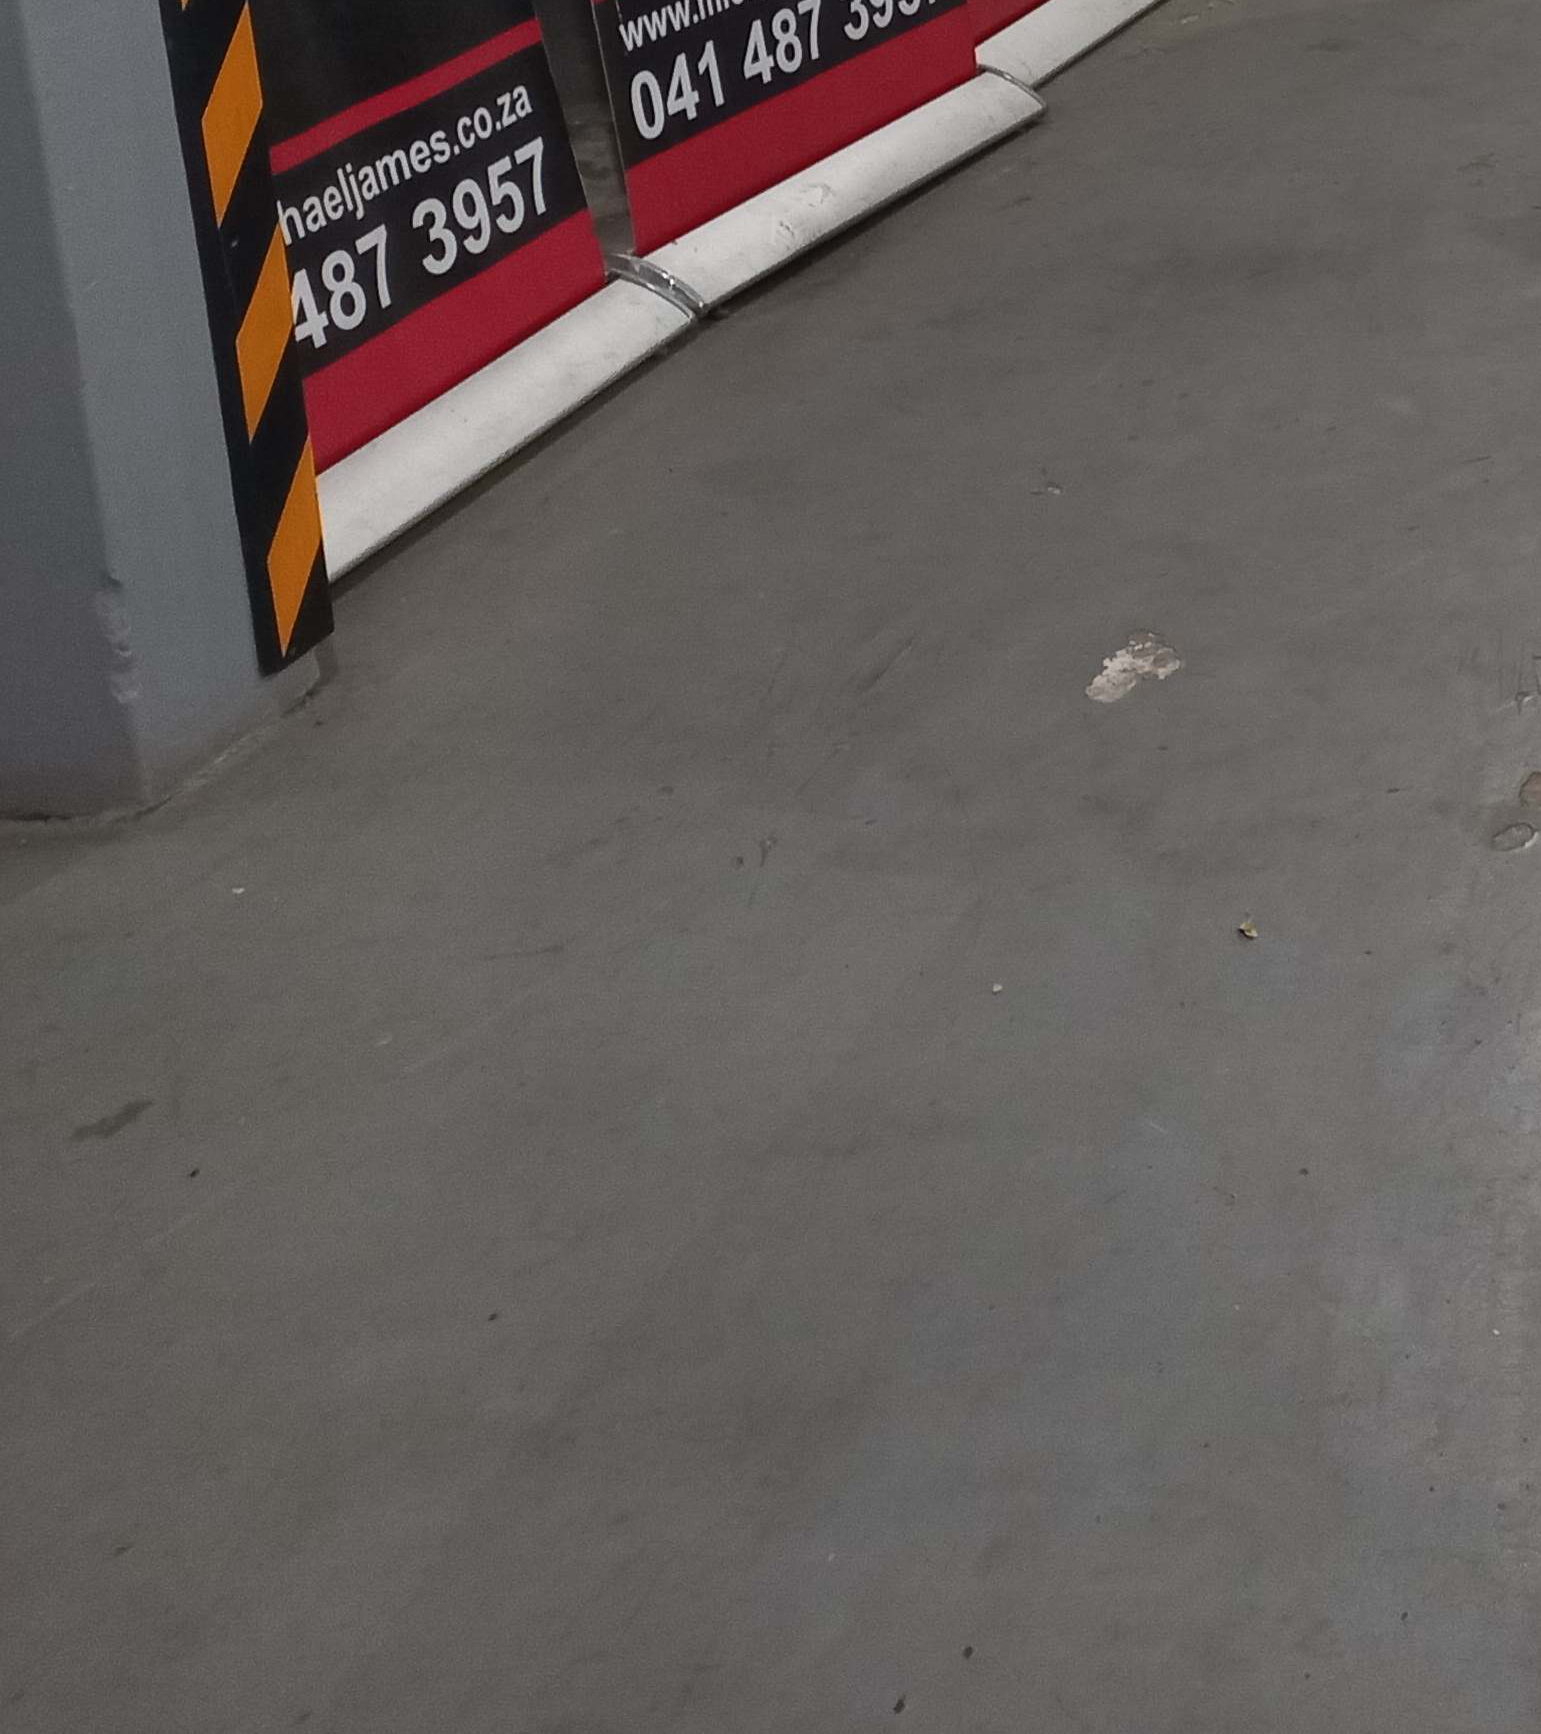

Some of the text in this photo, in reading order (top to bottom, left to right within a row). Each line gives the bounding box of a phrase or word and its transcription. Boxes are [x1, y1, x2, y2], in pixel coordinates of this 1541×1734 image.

[631, 39, 726, 141] 041
[291, 136, 548, 349] 487 3957
